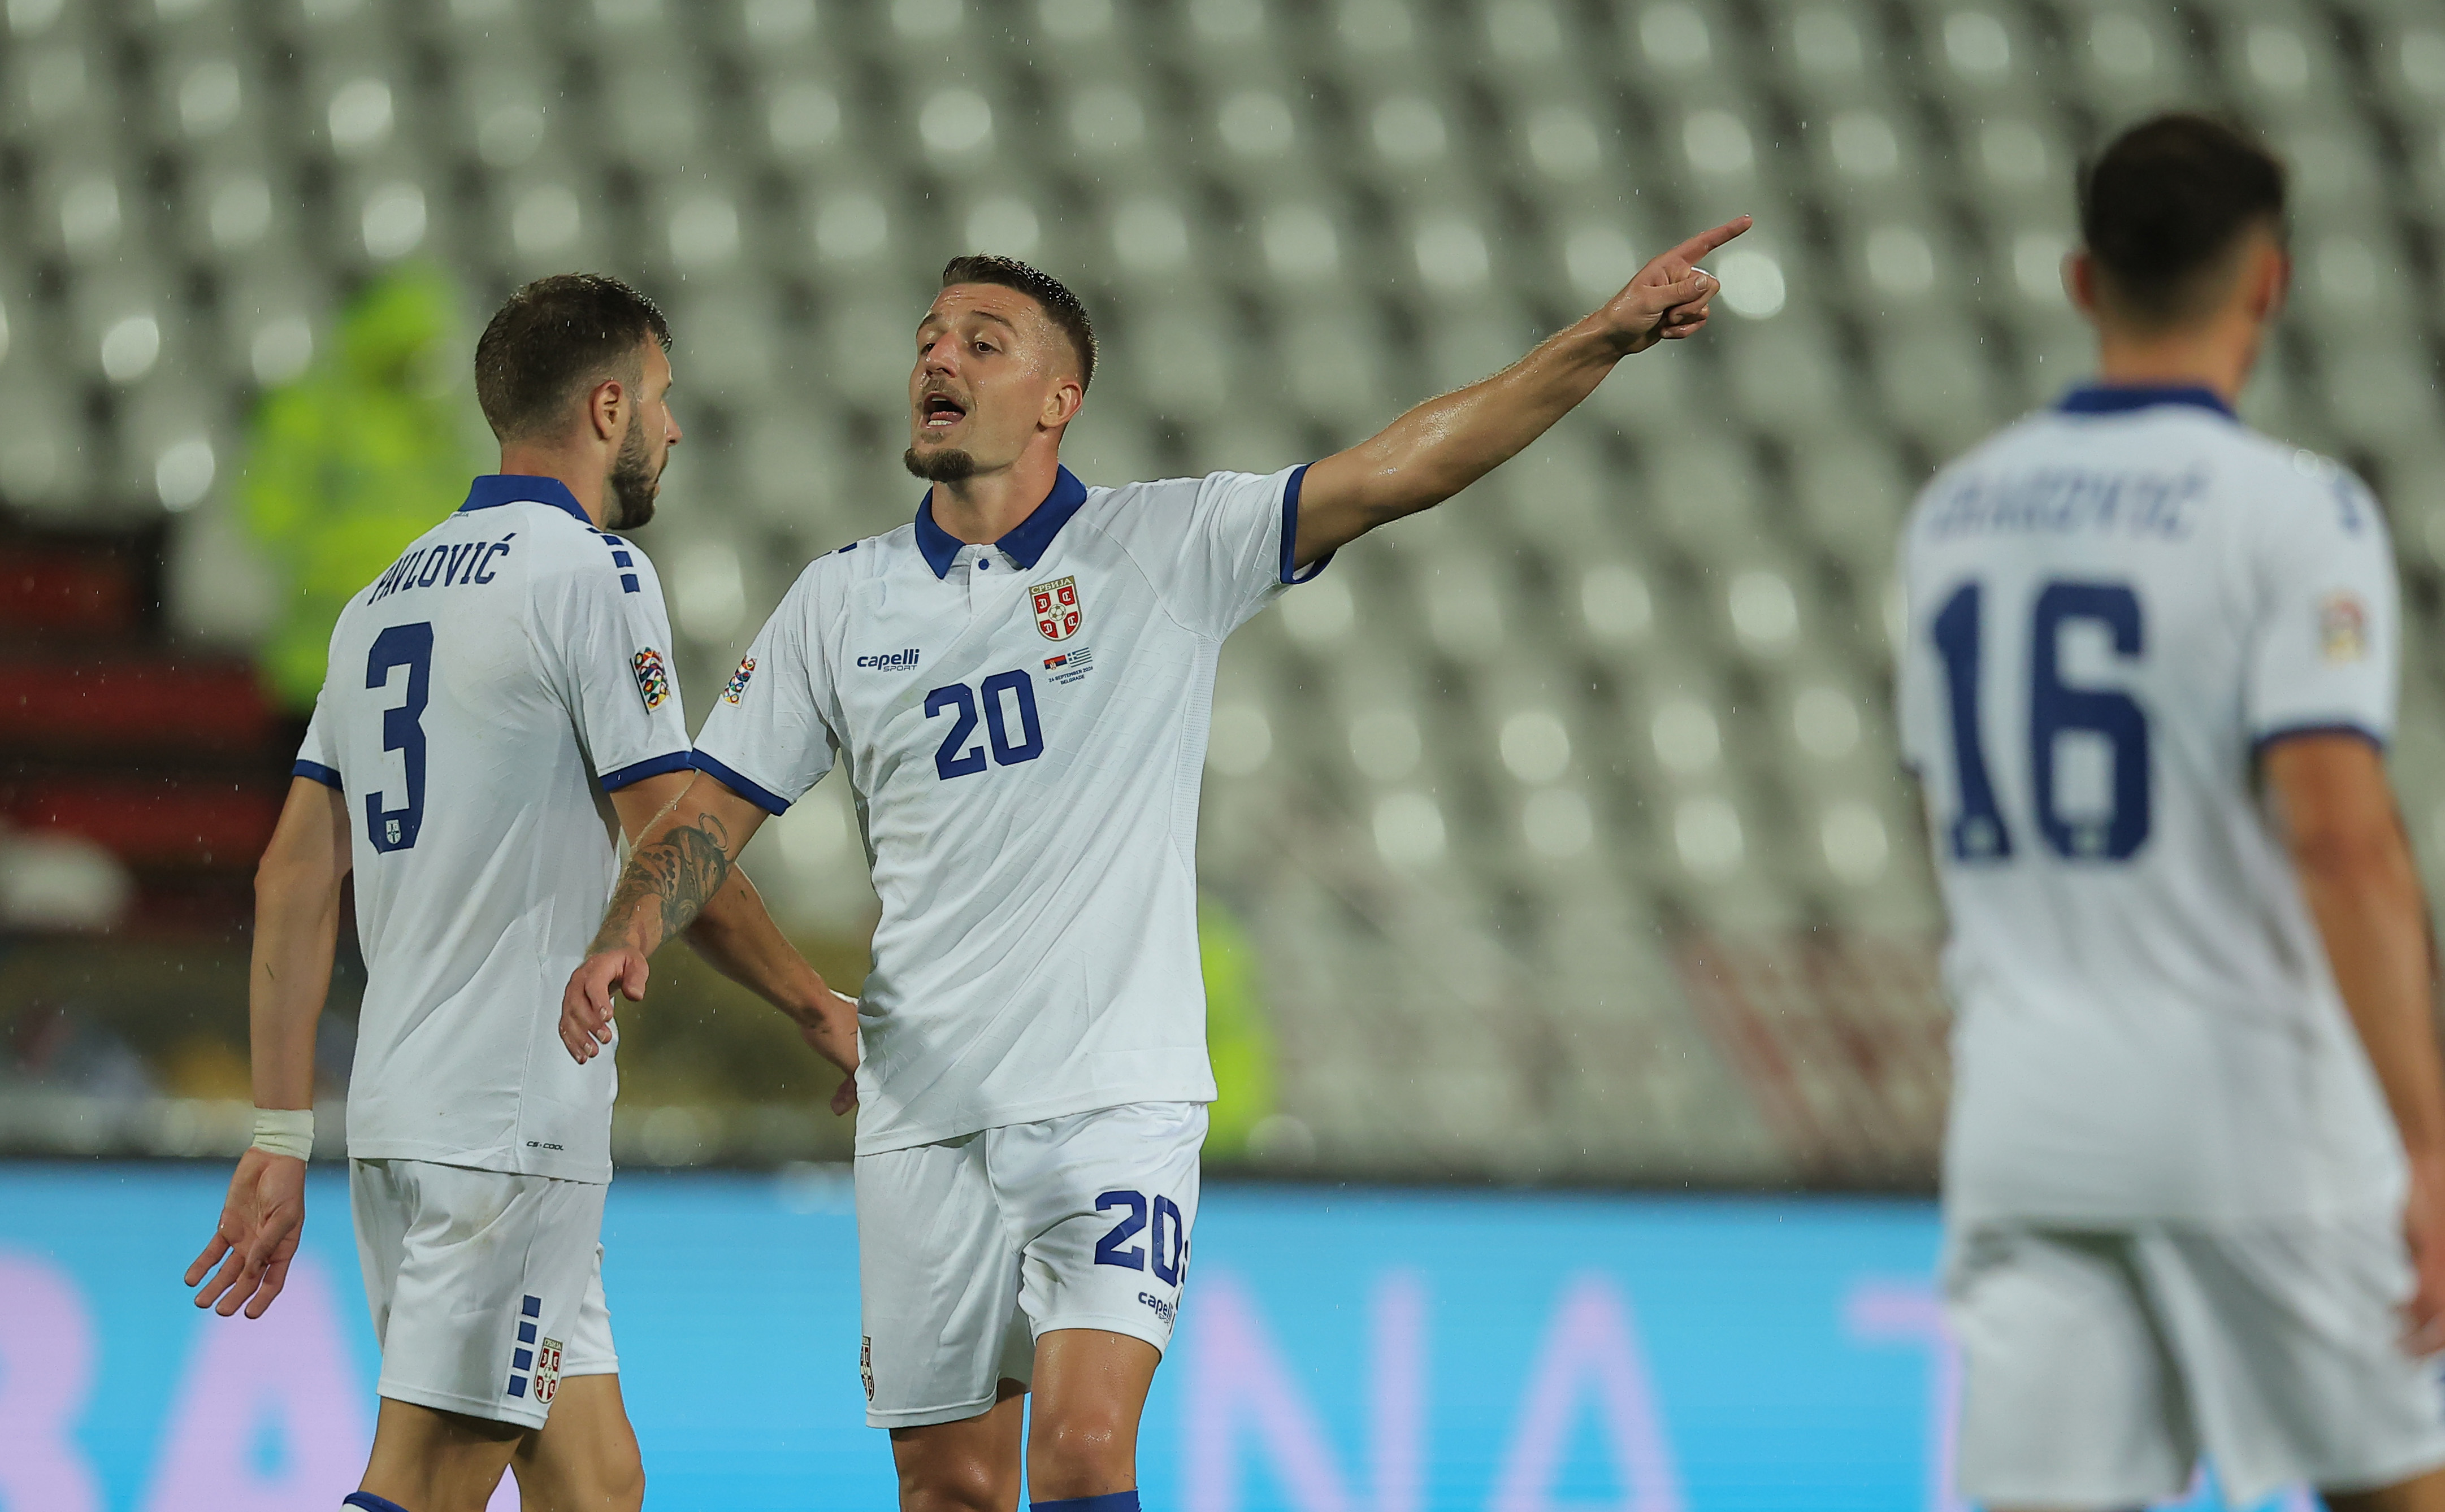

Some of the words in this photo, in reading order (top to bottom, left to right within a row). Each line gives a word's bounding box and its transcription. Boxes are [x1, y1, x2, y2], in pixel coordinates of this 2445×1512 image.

[367, 532, 517, 606] PAVLOVIĆ
[1031, 577, 1072, 594] СРБИЈА
[857, 649, 920, 671] capelli
[1055, 670, 1083, 681] SEPTEMBER
[1060, 674, 1085, 685] BELGRADE
[366, 621, 434, 855] 3
[924, 669, 1044, 781] 20
[1934, 582, 2151, 860] 16
[1094, 1190, 1183, 1288] 20
[1138, 1292, 1174, 1322] capelli
